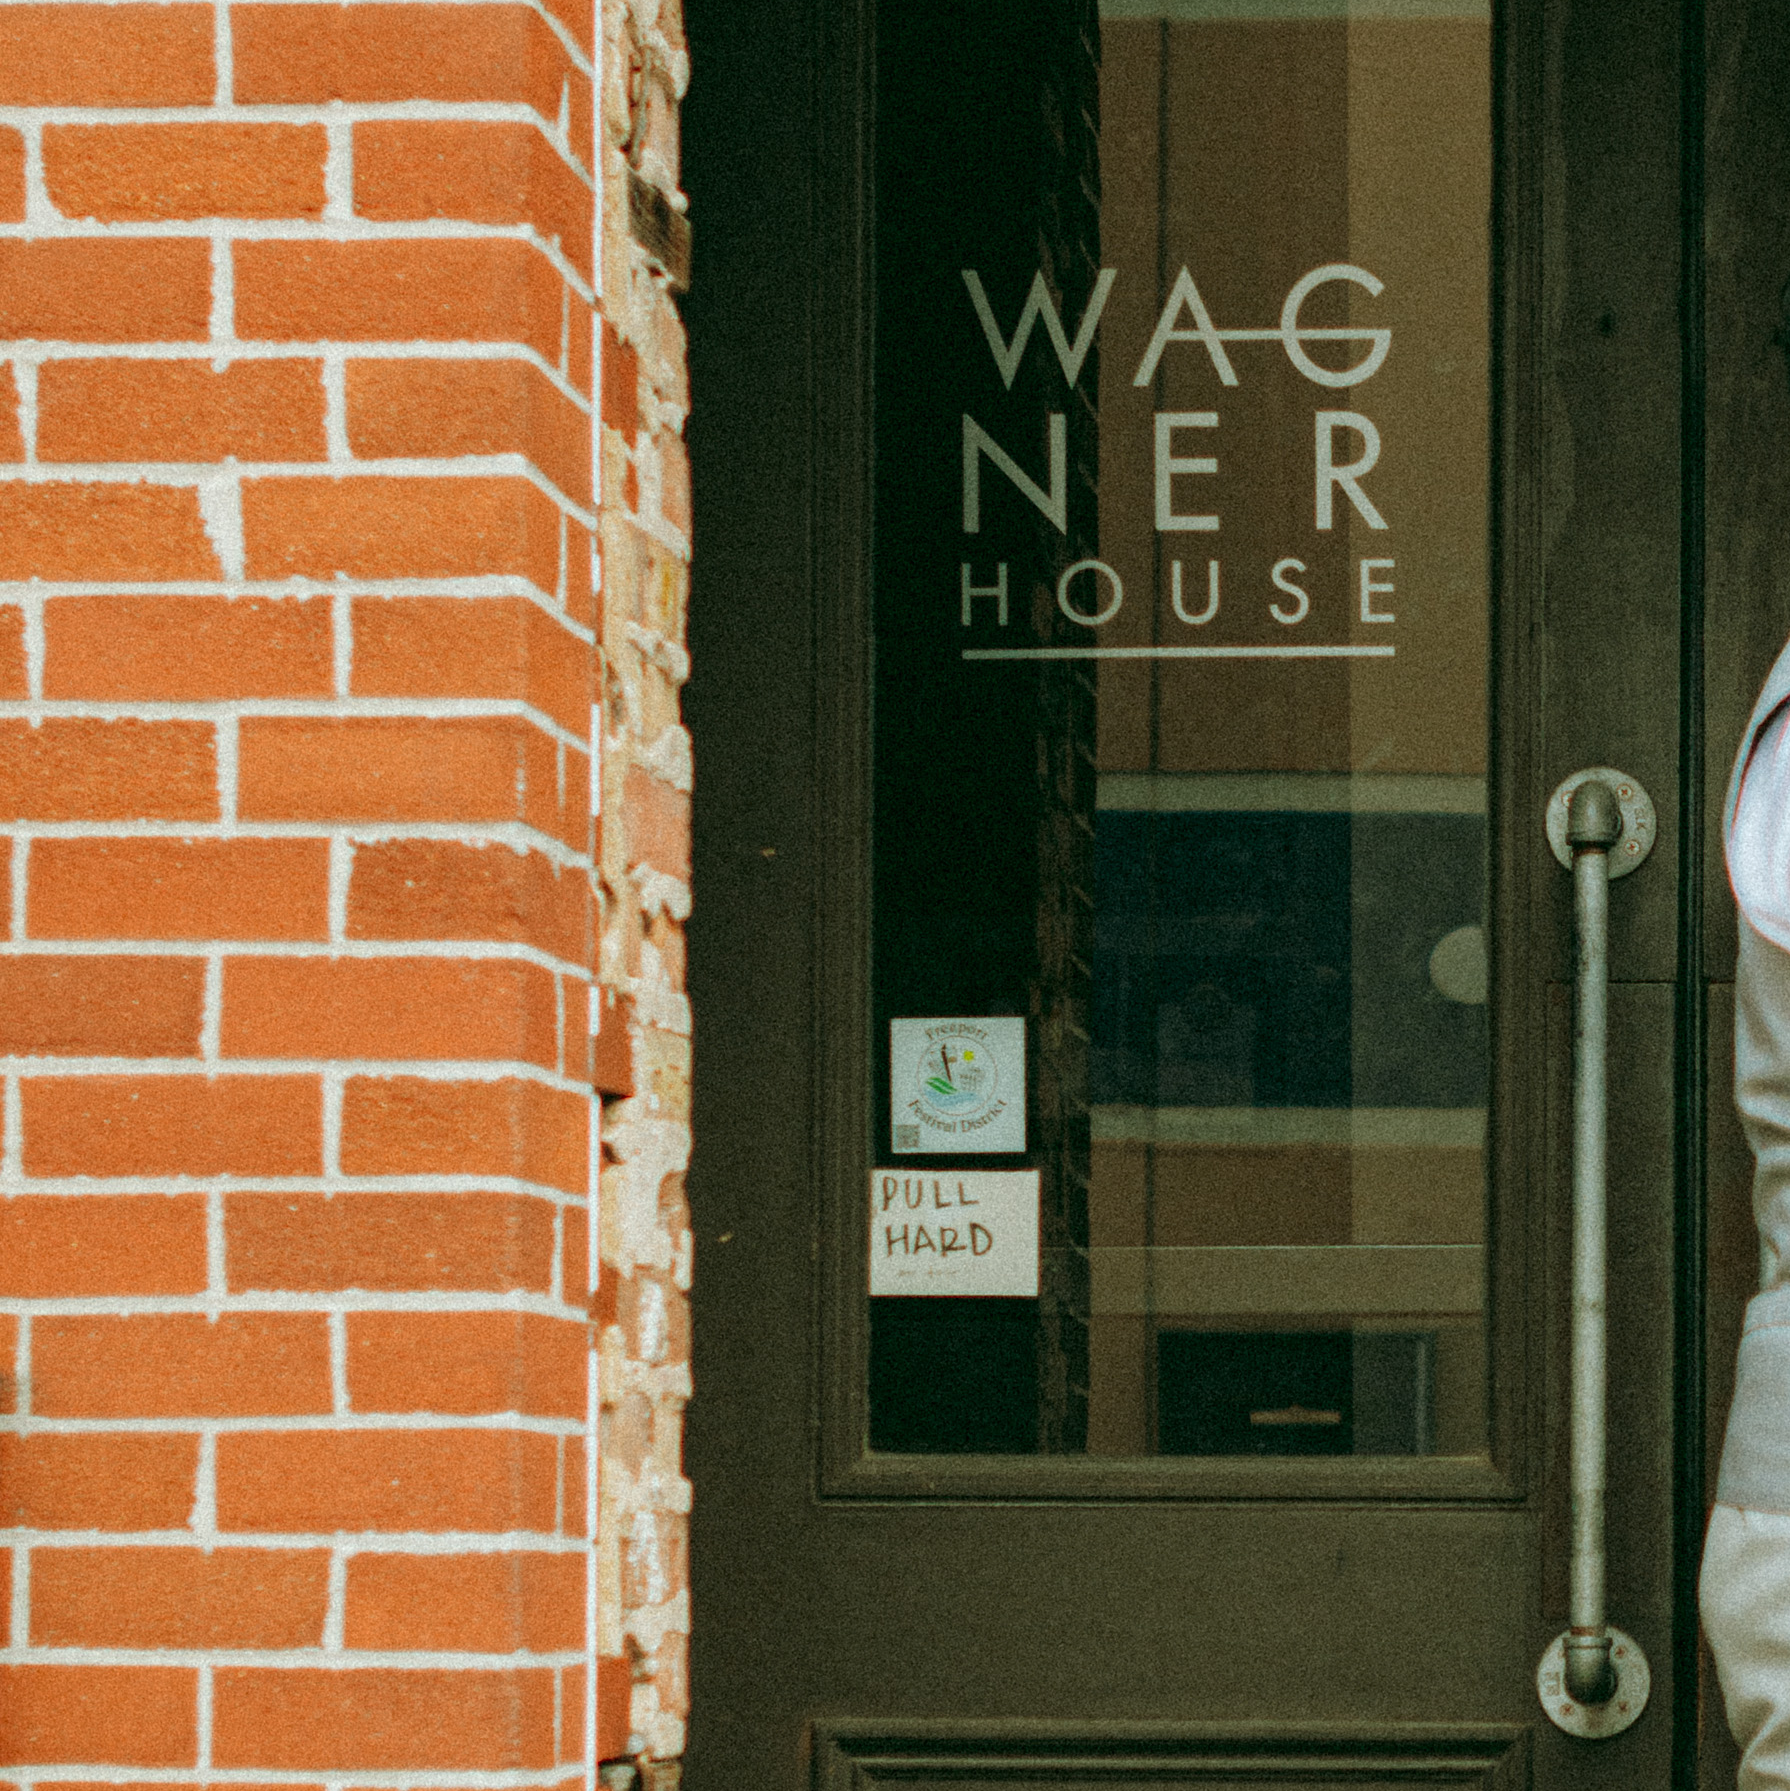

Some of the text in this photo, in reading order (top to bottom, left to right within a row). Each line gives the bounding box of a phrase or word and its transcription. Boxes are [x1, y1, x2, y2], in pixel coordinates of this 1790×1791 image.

[961, 264, 1392, 390] WAG
[961, 411, 1390, 535] NER
[960, 557, 1396, 627] HOUSE
[924, 1022, 989, 1042] Freeport
[907, 1098, 1008, 1134] Festival District
[882, 1176, 980, 1211] PULL
[886, 1222, 994, 1257] HARD
